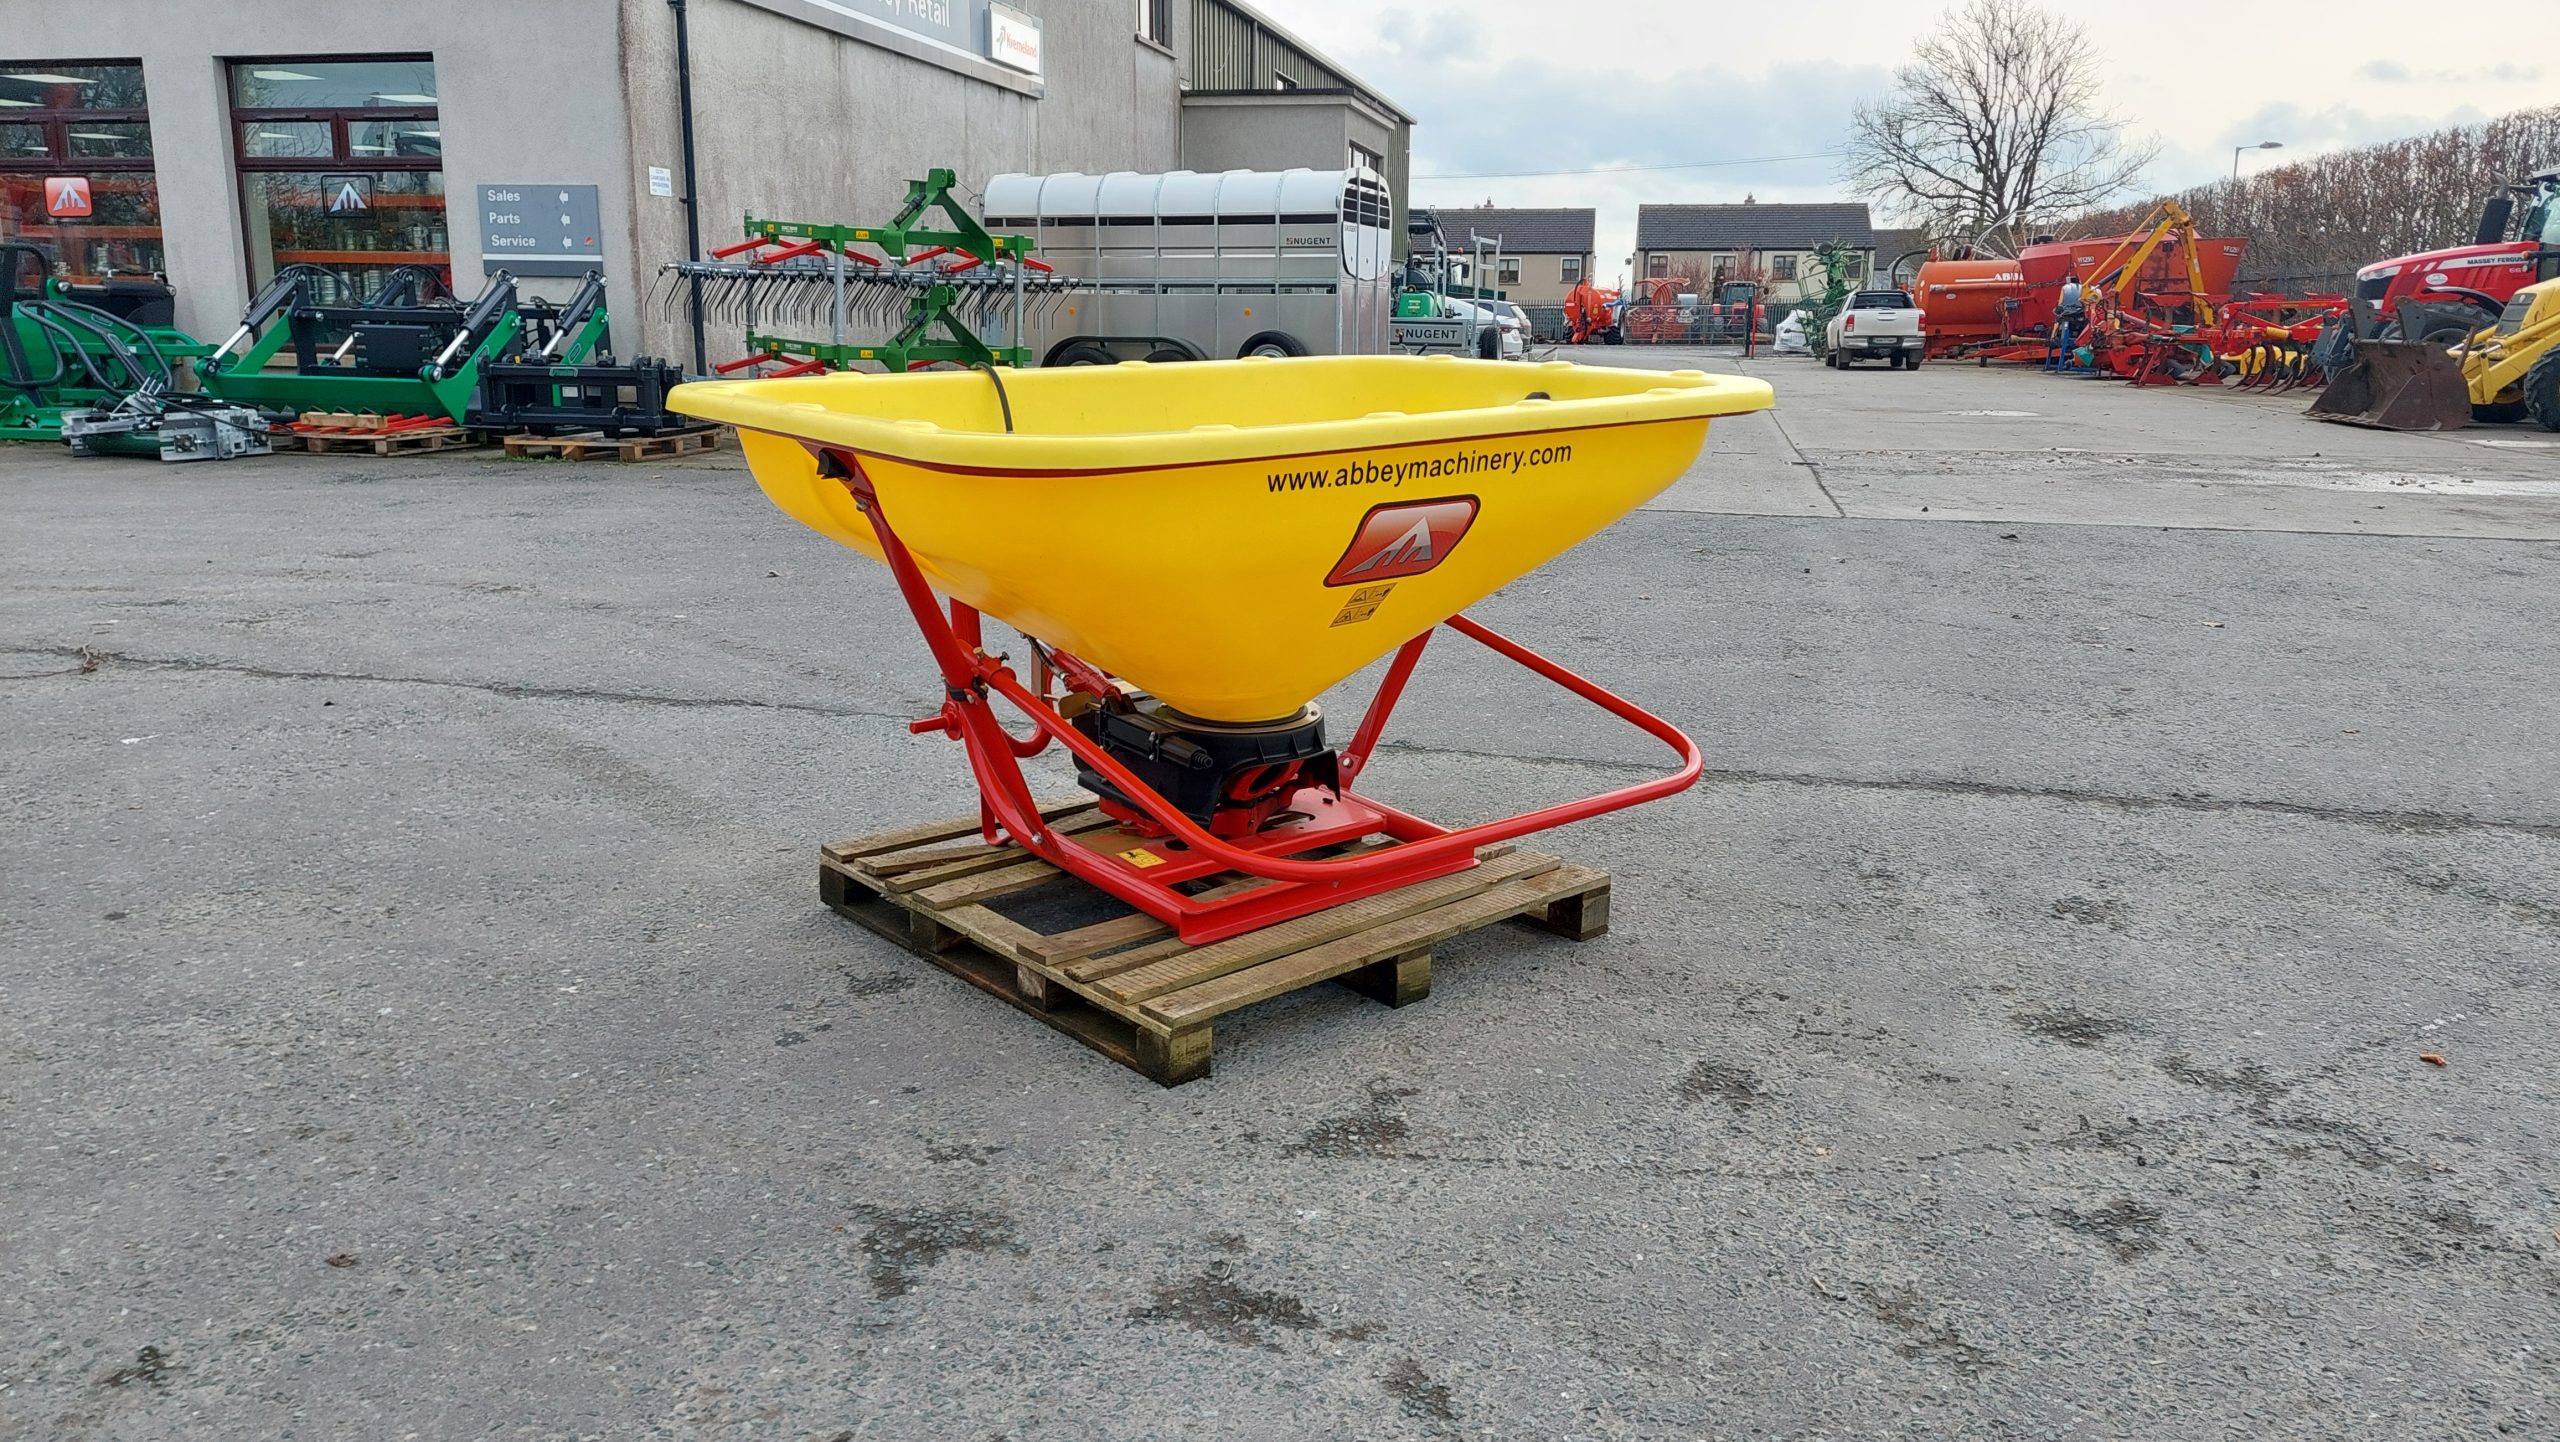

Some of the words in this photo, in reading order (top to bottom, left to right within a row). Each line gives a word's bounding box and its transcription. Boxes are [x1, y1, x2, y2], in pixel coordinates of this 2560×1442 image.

[487, 189, 521, 202] Sales
[488, 212, 521, 224] Parts
[491, 234, 536, 247] Service
[1293, 237, 1332, 246] NUGENT
[2466, 257, 2496, 265] MASSEY
[1405, 328, 1458, 339] NUGENT
[1266, 444, 1573, 493] www.abbeymachinery.com
